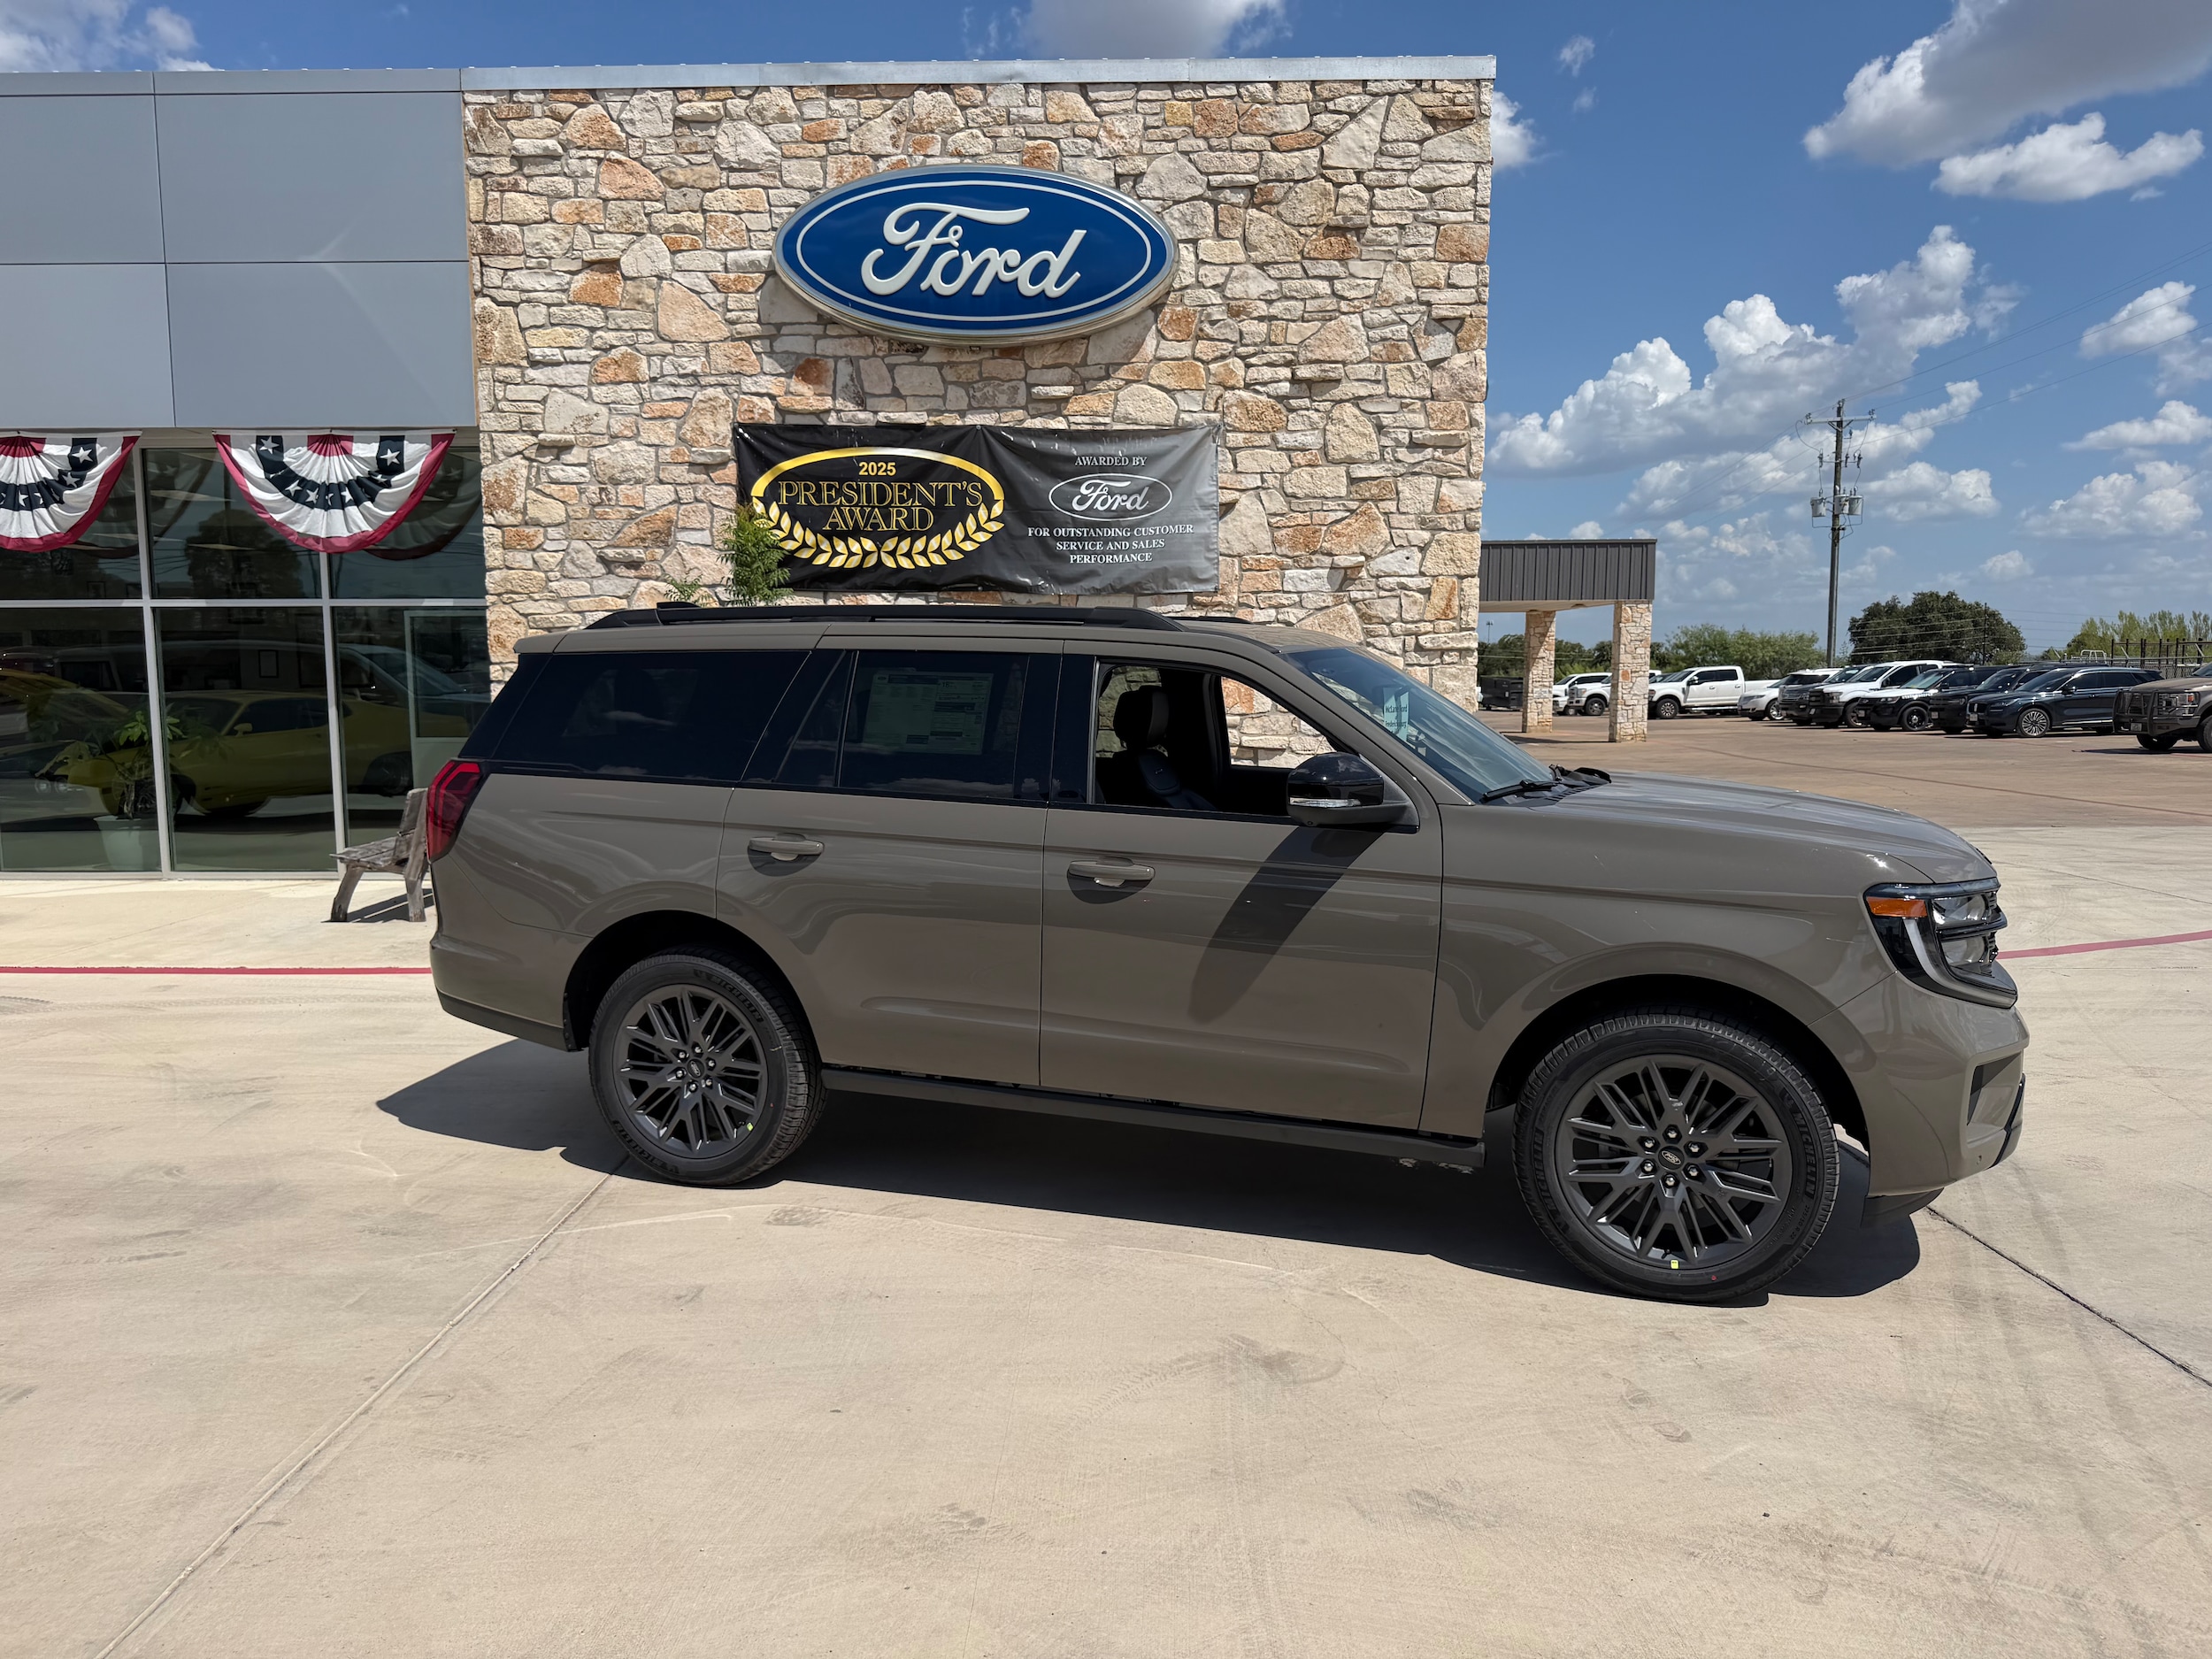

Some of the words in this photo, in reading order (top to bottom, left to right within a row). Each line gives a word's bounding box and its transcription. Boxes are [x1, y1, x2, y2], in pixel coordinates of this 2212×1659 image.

[861, 202, 1087, 299] Ford
[858, 462, 896, 476] 2025
[1074, 457, 1129, 466] AWARDED
[1132, 456, 1148, 466] BY
[778, 480, 983, 507] PRESIDENT'S
[1071, 479, 1148, 511] Ford
[822, 506, 934, 531] AWARD
[1028, 527, 1050, 537] FOR
[1053, 526, 1131, 537] OUTSTANDING
[1133, 525, 1194, 536] CUSTOMER
[1056, 541, 1103, 550] SERVICE
[1106, 541, 1129, 550] AND
[1132, 539, 1165, 549] SALES
[1070, 553, 1152, 564] PERFORMANCE
[1793, 1112, 1816, 1200] MICHELIN
